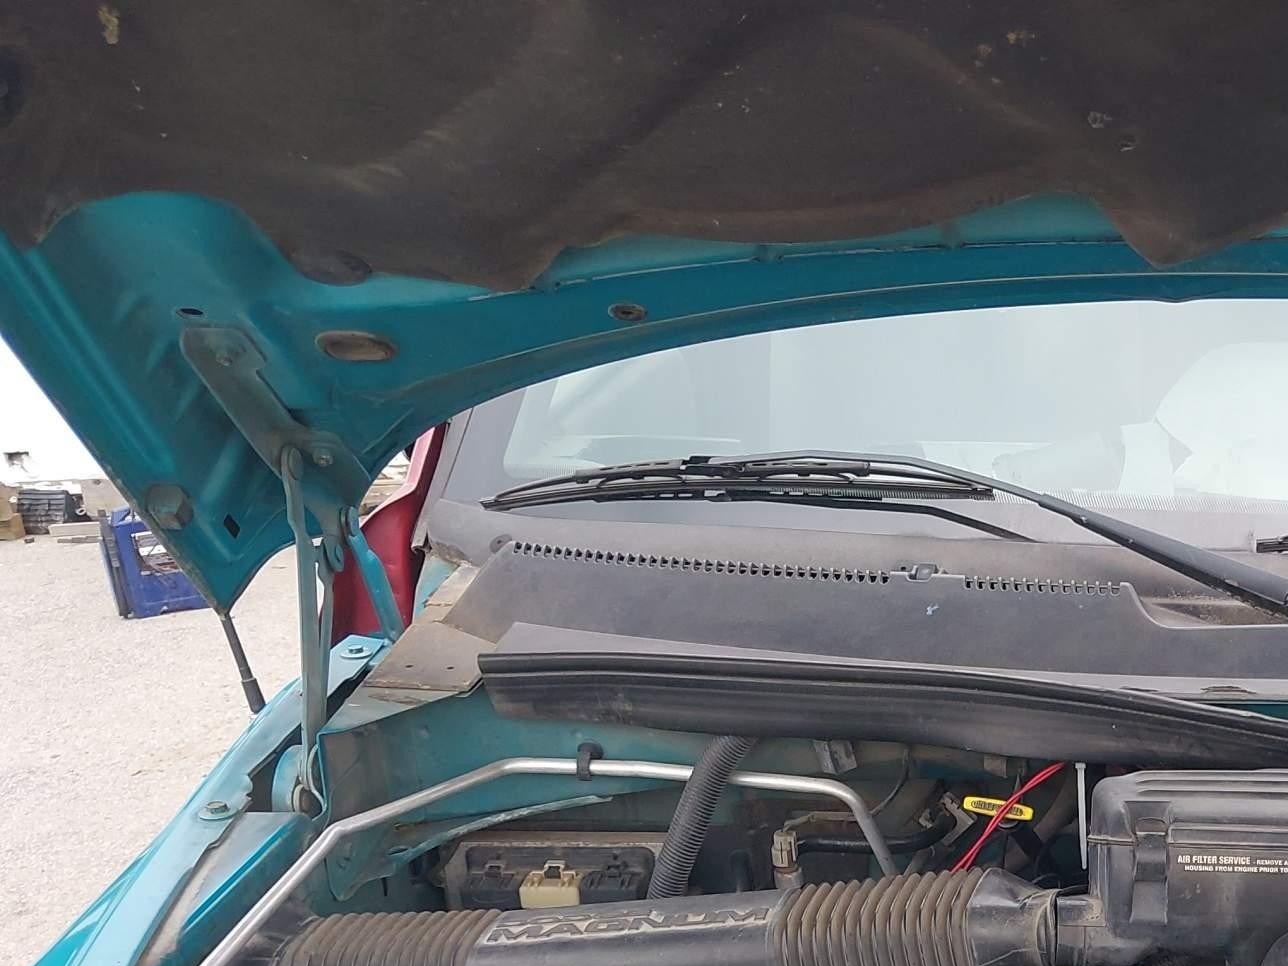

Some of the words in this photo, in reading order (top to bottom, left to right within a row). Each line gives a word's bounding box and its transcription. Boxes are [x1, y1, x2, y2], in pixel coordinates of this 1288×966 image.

[1178, 855, 1190, 864] AIR
[1192, 855, 1217, 864] FILTER
[1219, 856, 1250, 865] SERVICE
[486, 906, 772, 944] MAGNUM
